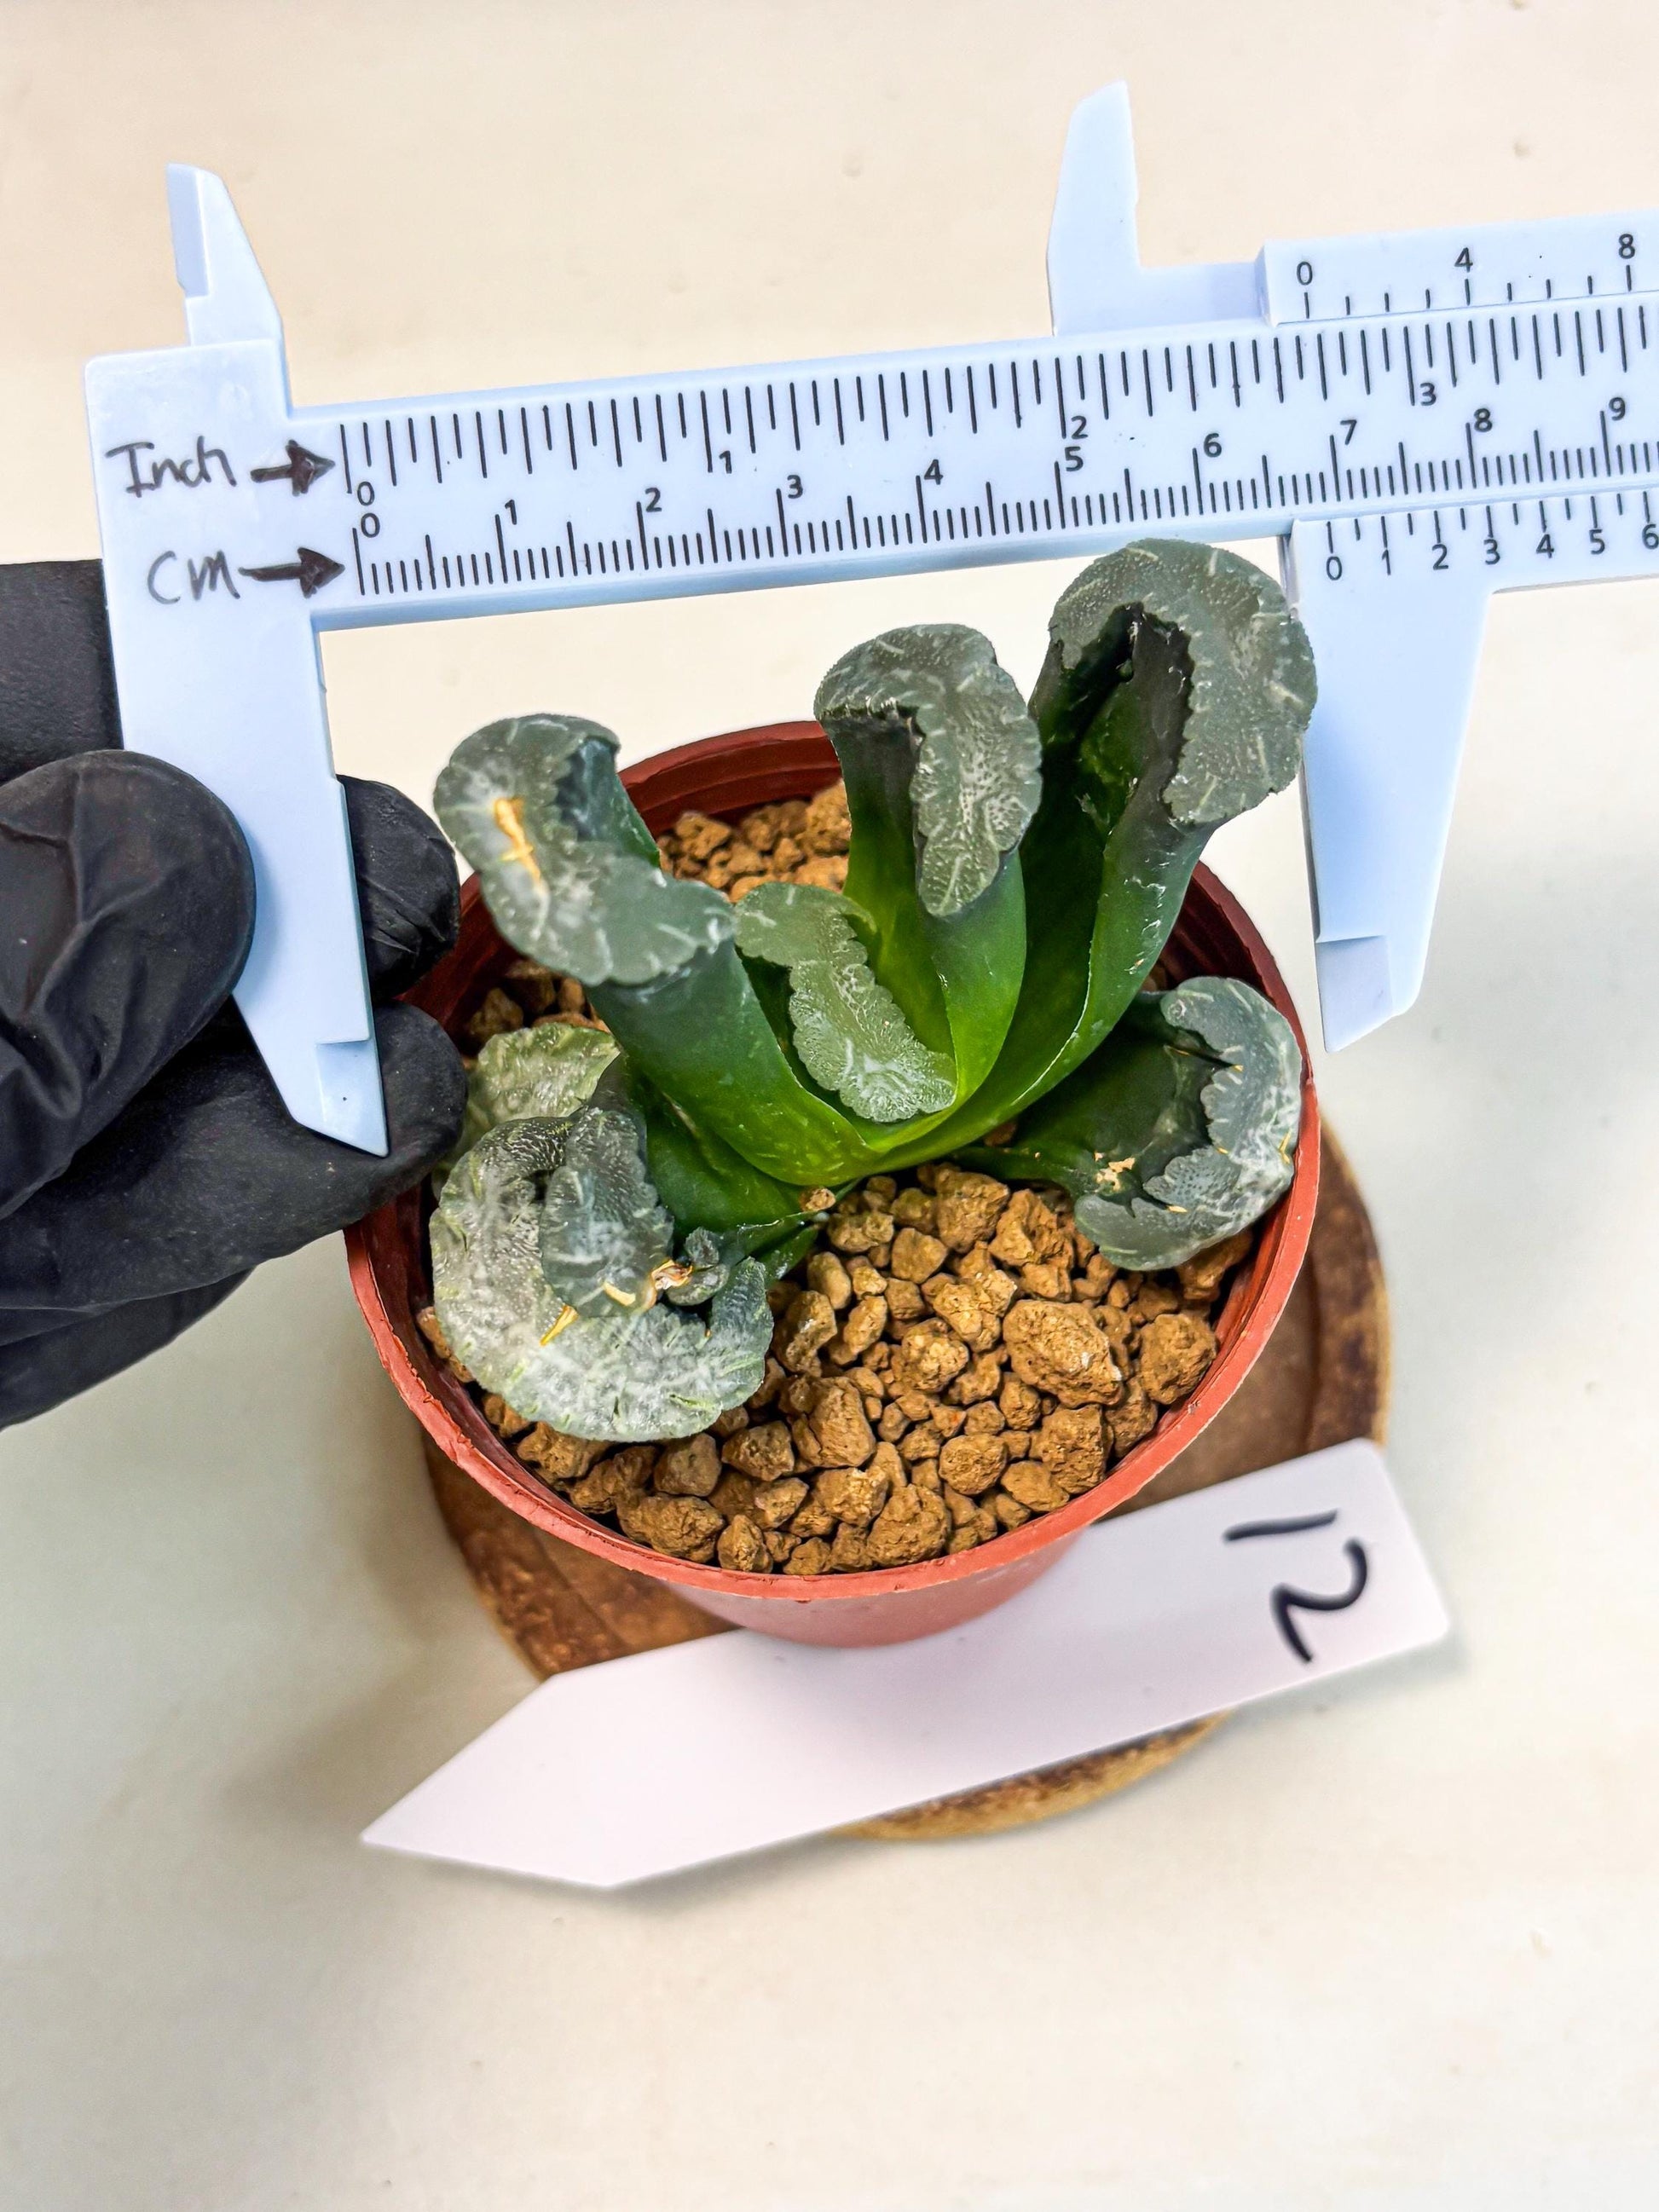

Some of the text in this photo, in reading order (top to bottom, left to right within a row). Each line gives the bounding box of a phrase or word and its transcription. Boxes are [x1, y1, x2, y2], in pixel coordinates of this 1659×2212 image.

[1296, 234, 1636, 286] 0 4 8
[105, 436, 237, 498] Inch
[357, 382, 1436, 506] 0 1 2 3
[361, 396, 1627, 538] 0 1 2 3 4 5 6 7 8 9
[1326, 524, 1659, 581] 0 1 2 3 4 5 6
[1222, 1508, 1369, 1665] 12
